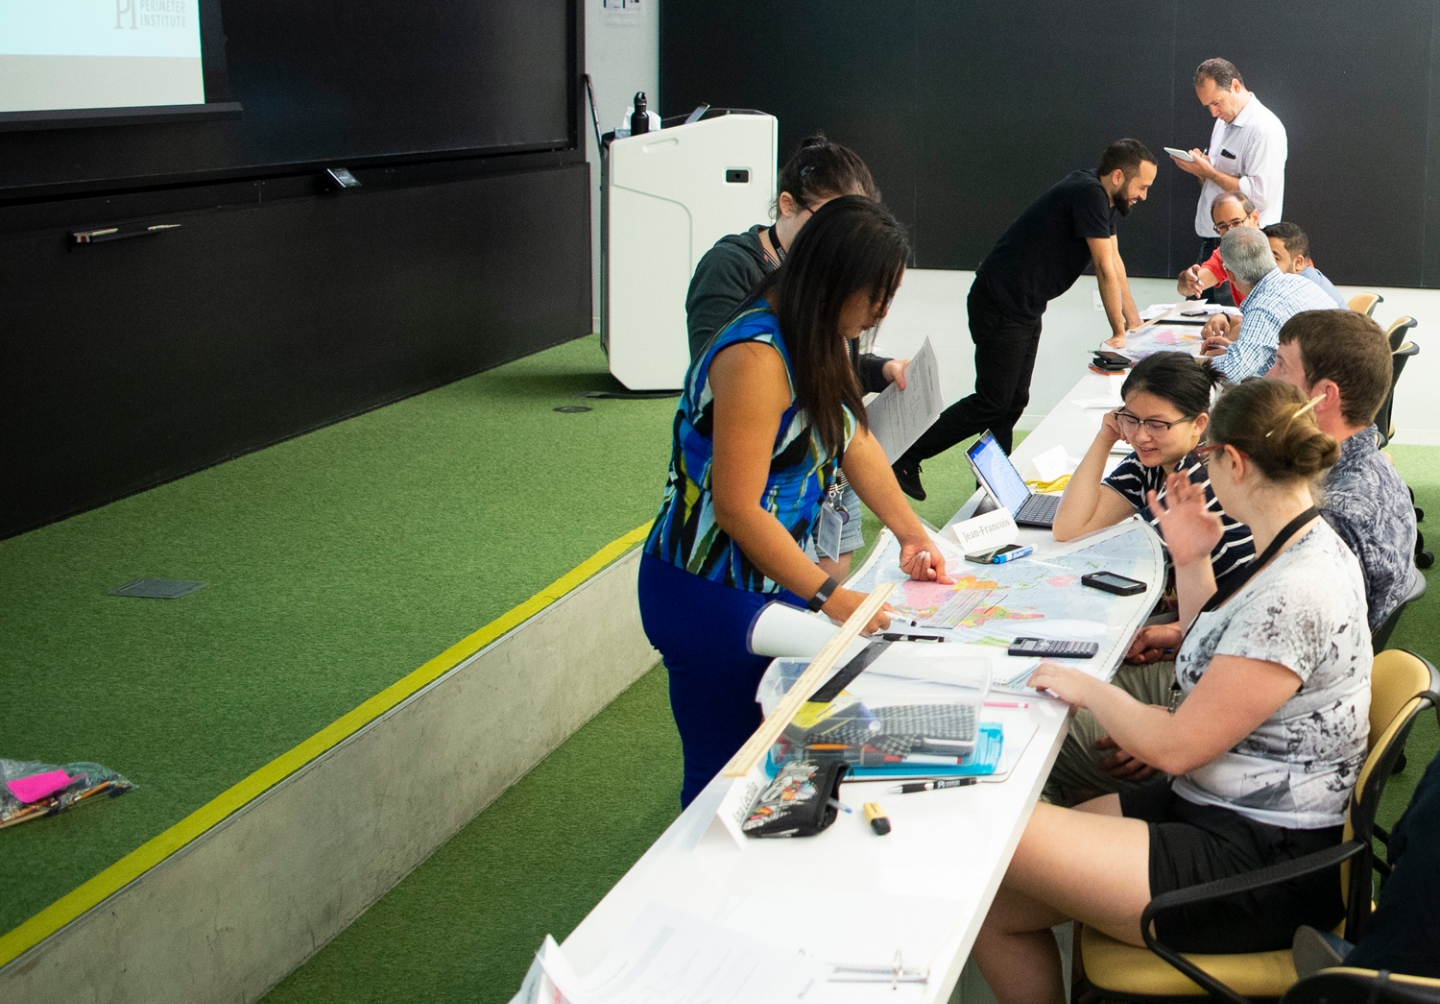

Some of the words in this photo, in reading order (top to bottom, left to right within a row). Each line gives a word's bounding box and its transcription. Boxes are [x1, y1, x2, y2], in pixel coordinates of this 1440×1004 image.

[140, 0, 186, 13] PERIMETER
[140, 14, 186, 28] INSTITUTE
[962, 518, 1010, 542] Jean-Francois
